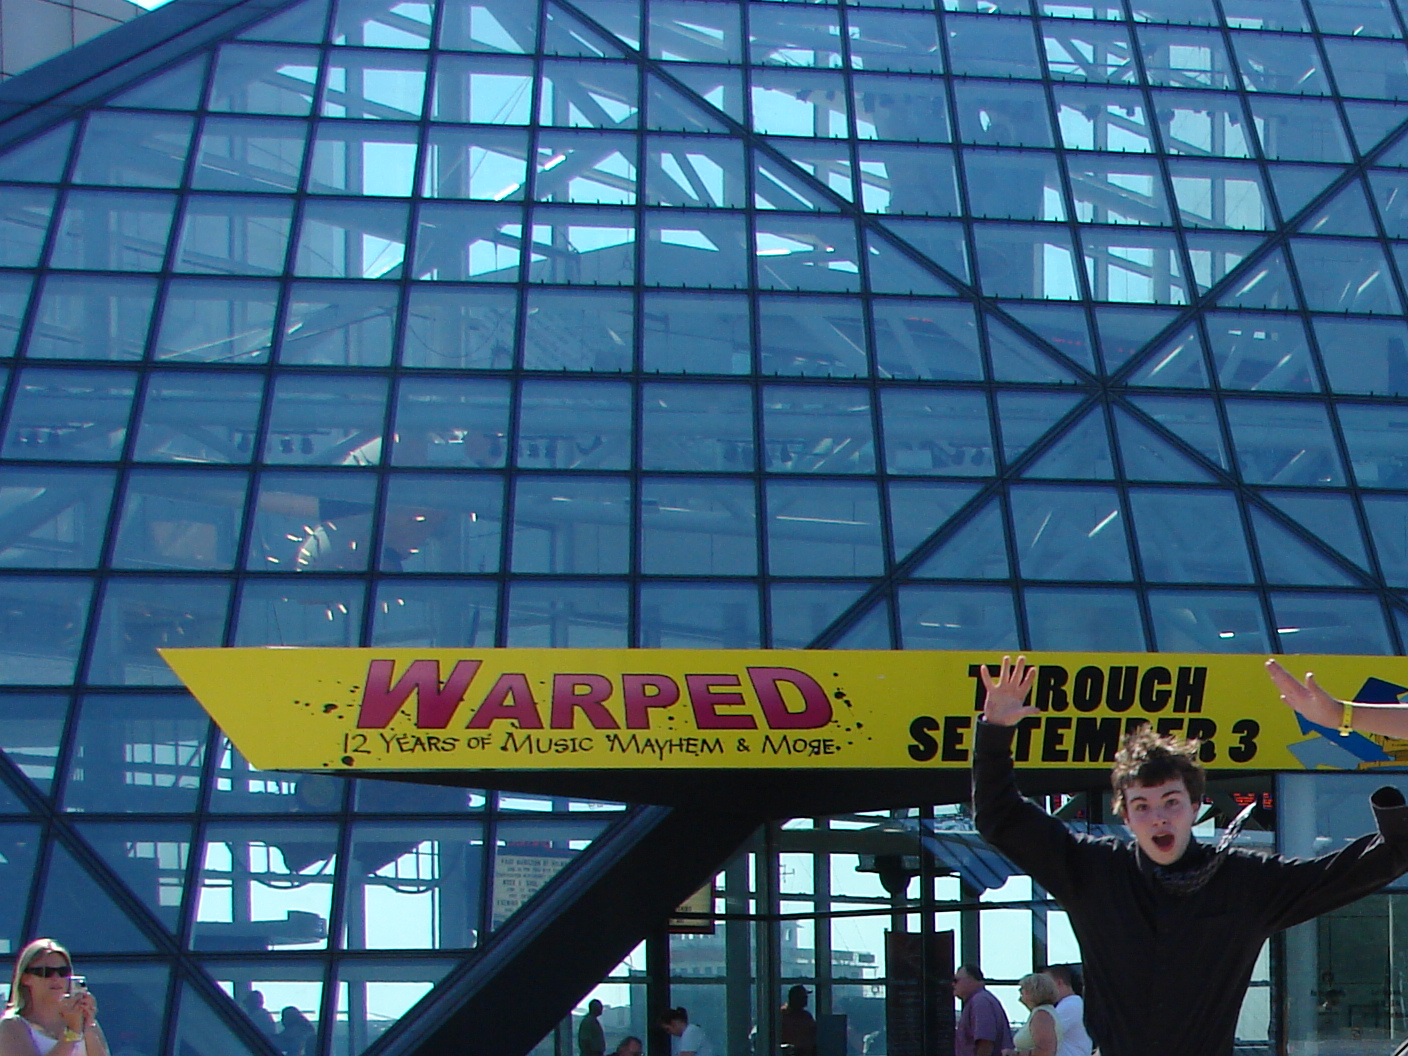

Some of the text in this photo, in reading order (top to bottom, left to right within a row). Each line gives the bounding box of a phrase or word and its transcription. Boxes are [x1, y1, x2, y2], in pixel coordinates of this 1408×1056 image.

[357, 660, 834, 730] WARPED
[968, 664, 1207, 713] TROUGH
[344, 733, 371, 755] 12
[380, 733, 459, 753] YEARS
[467, 734, 492, 750] OF
[500, 732, 594, 754] MUSIC
[606, 734, 724, 761] MAYHEM
[736, 738, 750, 753] &
[908, 715, 1260, 763] SETEMR 3
